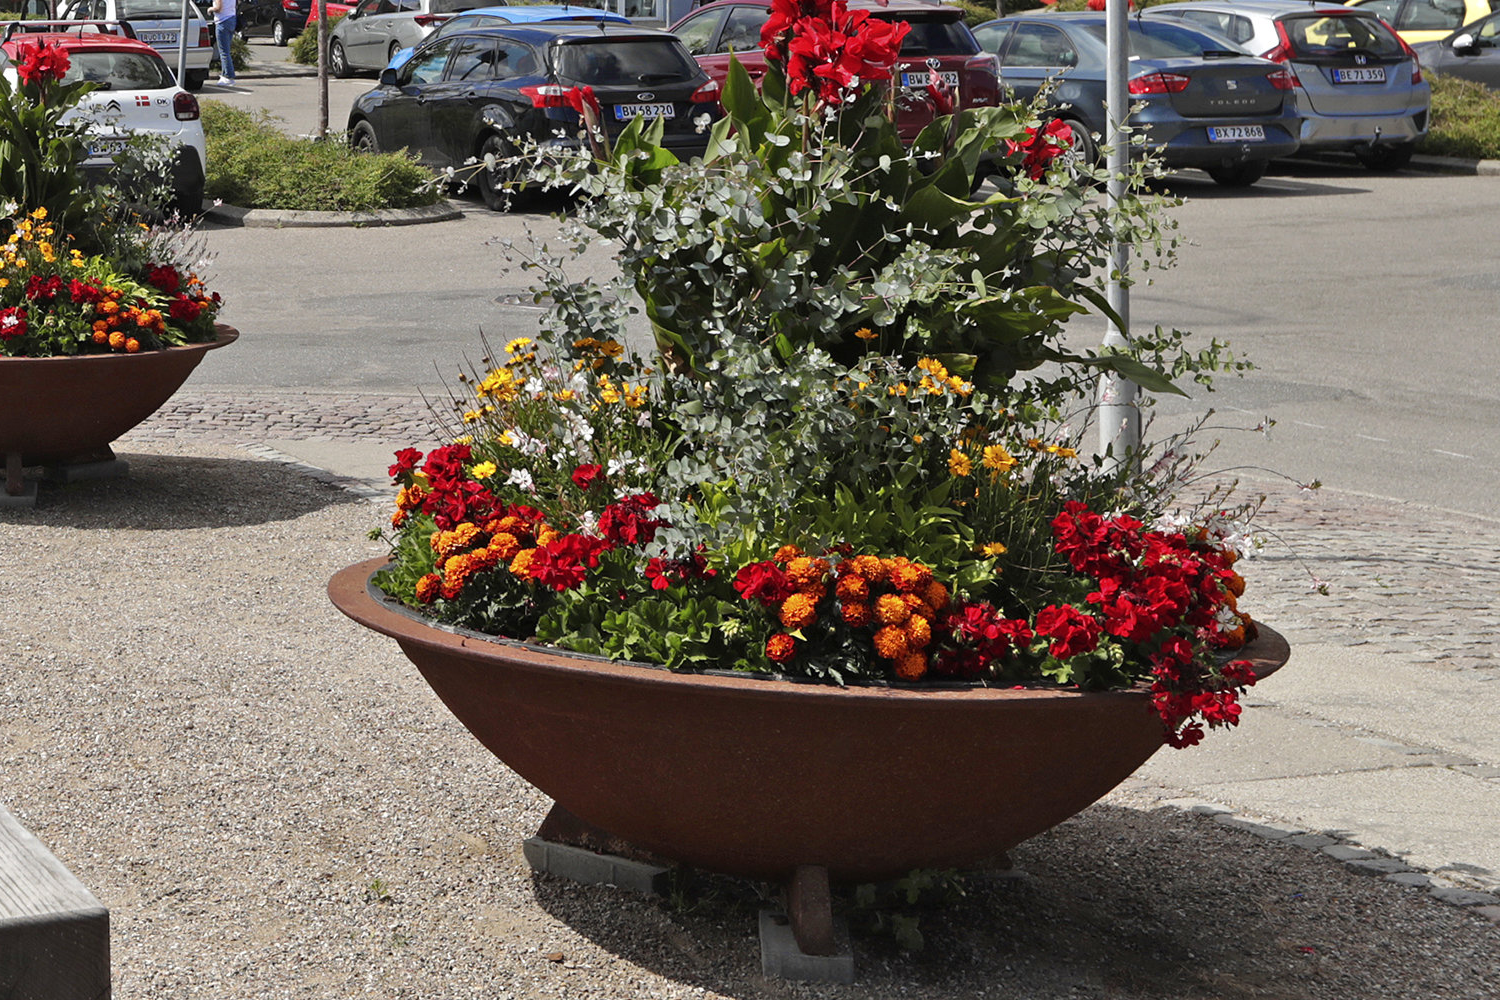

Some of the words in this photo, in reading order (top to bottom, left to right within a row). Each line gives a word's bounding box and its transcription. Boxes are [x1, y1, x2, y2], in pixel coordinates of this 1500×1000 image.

[909, 75, 923, 85] BW
[1340, 70, 1353, 80] BE
[1366, 69, 1383, 79] 359
[622, 106, 637, 116] BW
[639, 105, 652, 115] 68
[653, 105, 673, 115] 220
[1215, 128, 1229, 138] BX
[1230, 127, 1243, 137] 72
[1244, 126, 1263, 137] 868
